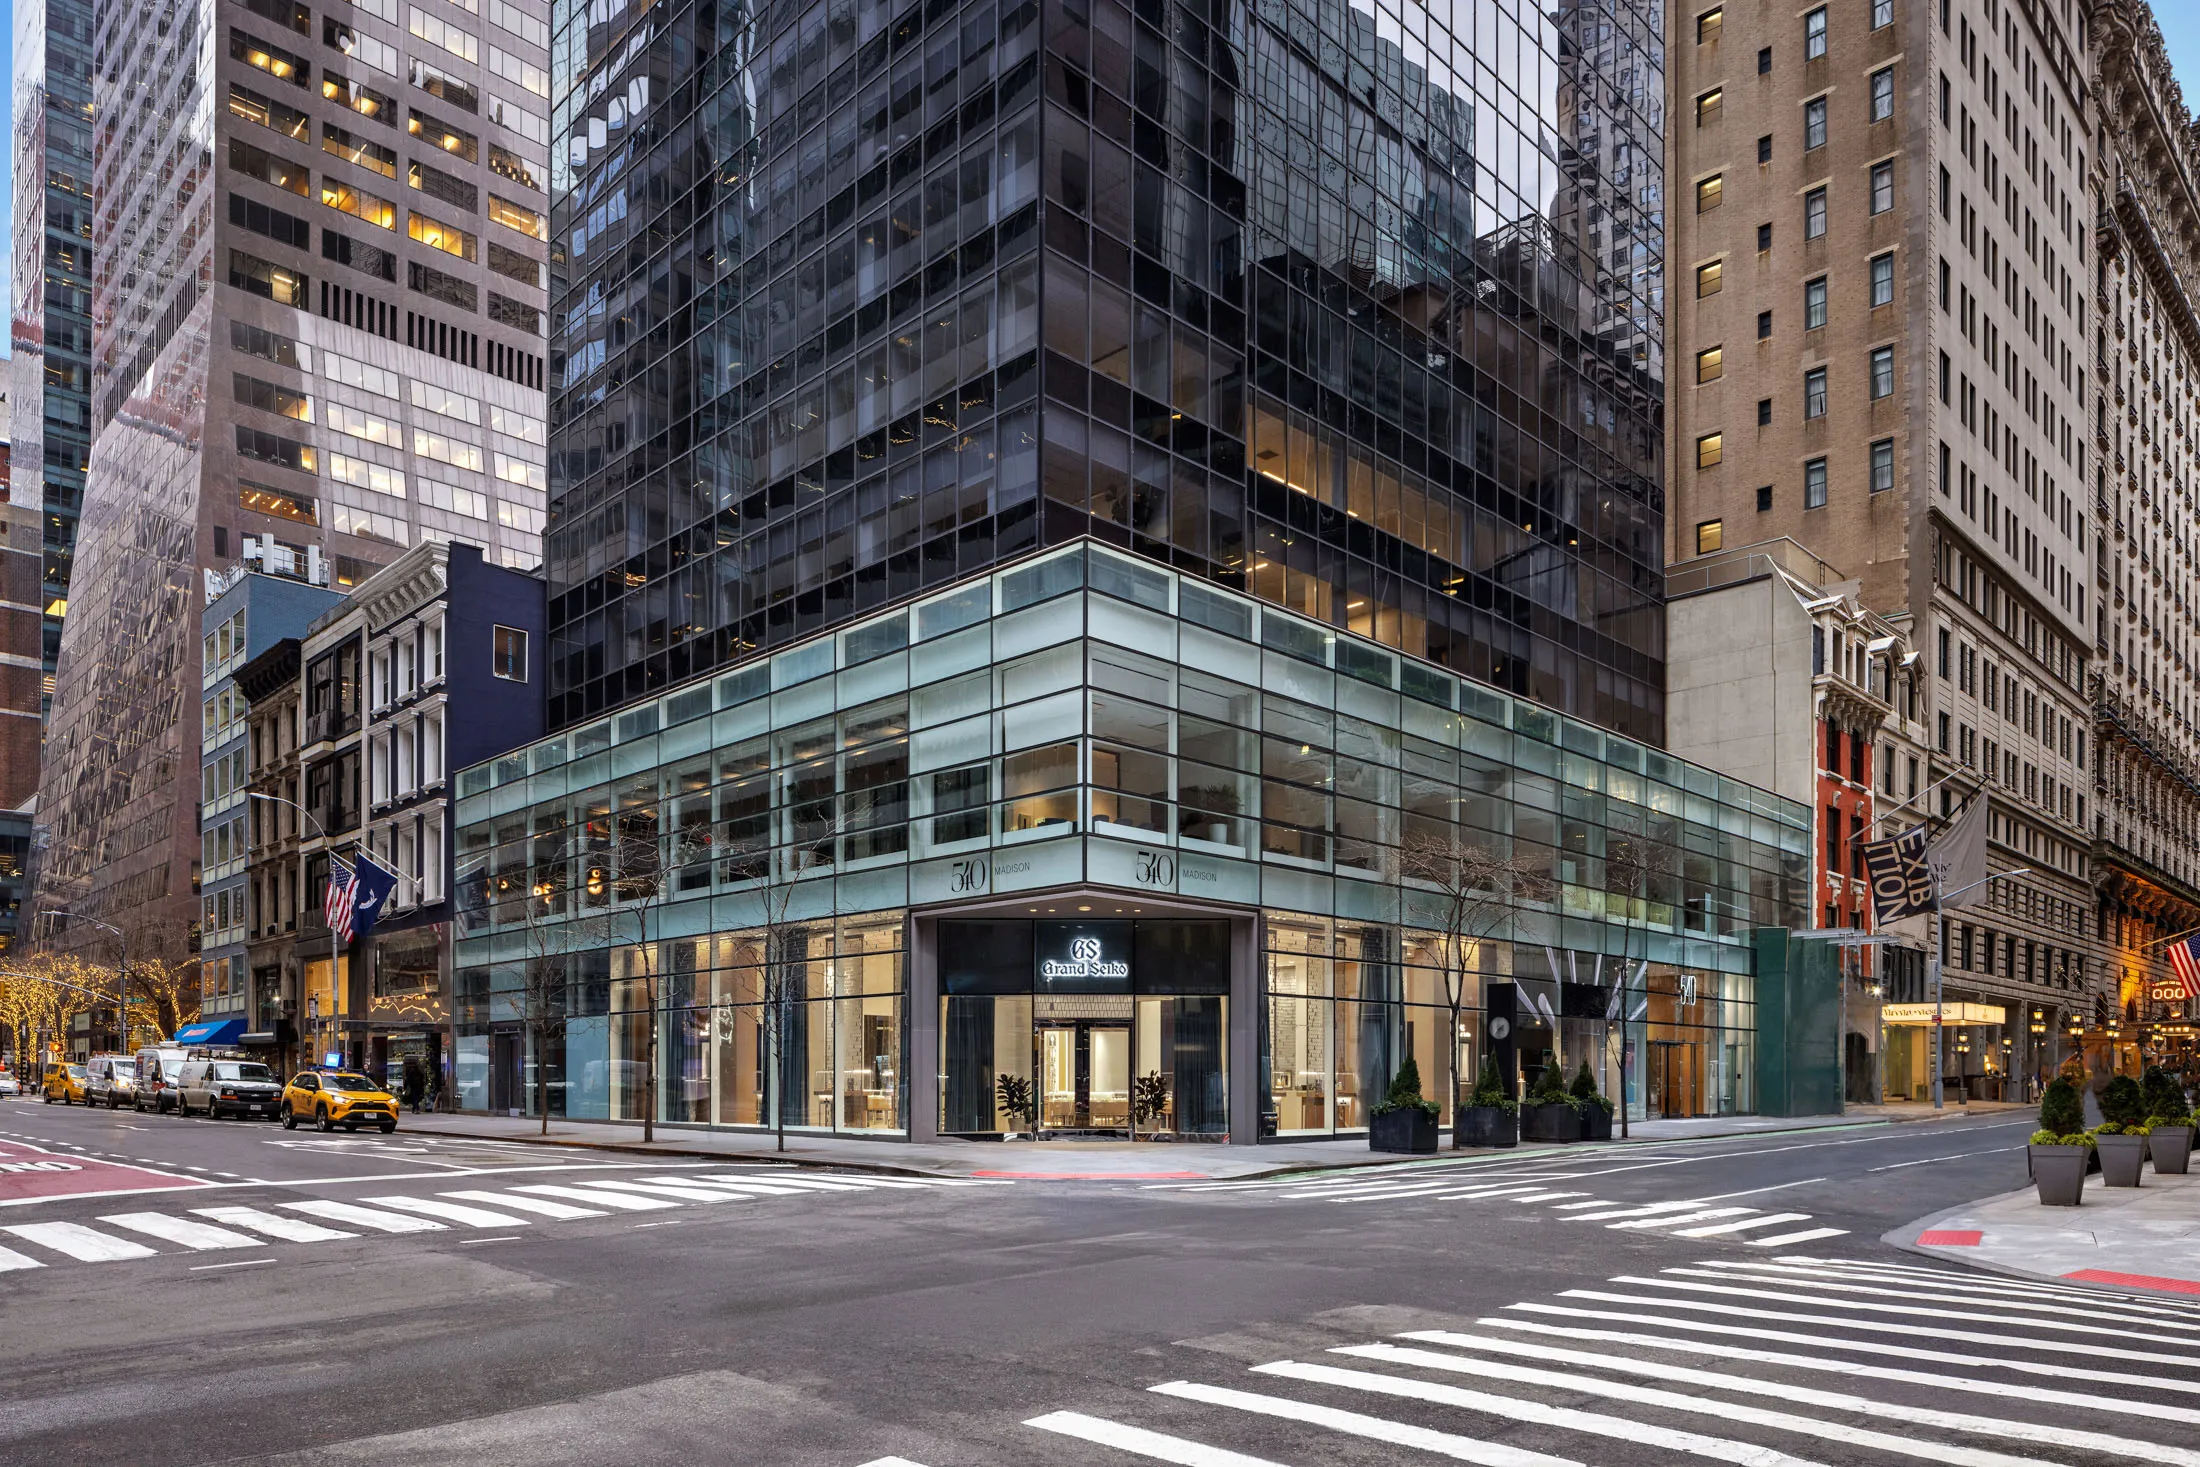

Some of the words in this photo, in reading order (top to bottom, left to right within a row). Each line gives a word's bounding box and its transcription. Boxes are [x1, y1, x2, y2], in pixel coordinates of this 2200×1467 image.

[951, 859, 986, 893] 540
[994, 862, 1031, 876] MADISON
[1136, 851, 1173, 886] 540
[1182, 868, 1217, 882] MADISON
[1072, 939, 1098, 960] GS
[1042, 961, 1085, 975] Grand
[1090, 961, 1127, 975] Seiko
[1680, 974, 1697, 1006] 540
